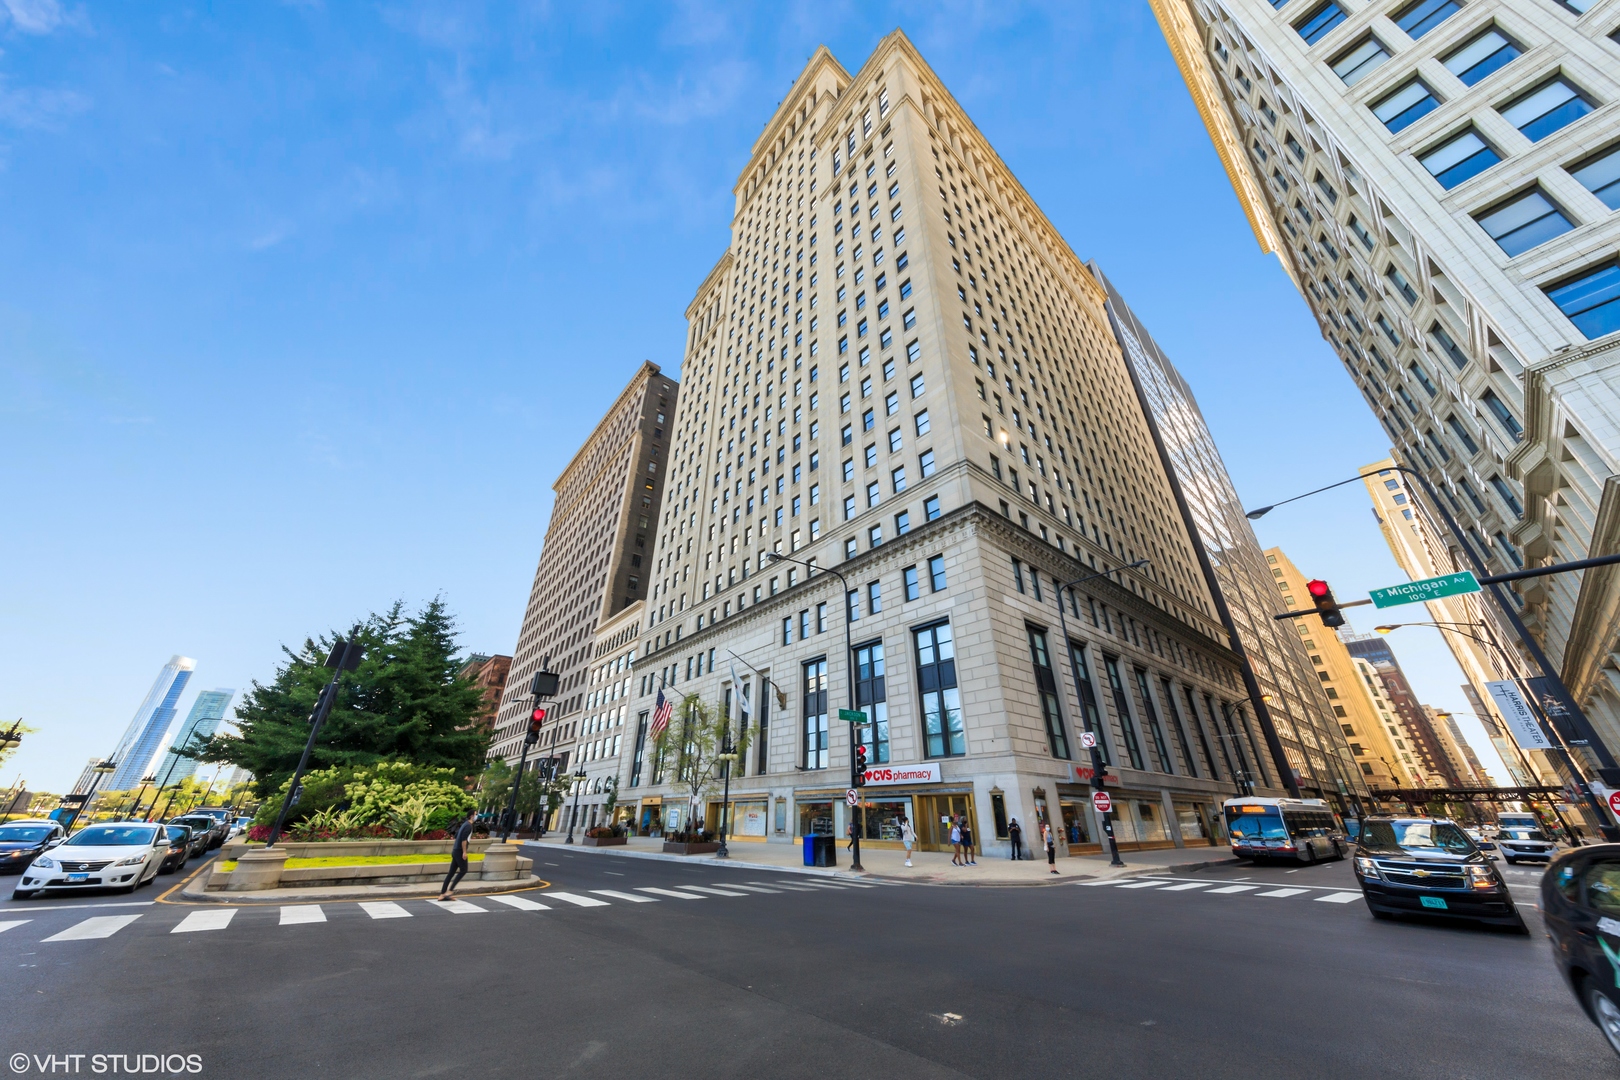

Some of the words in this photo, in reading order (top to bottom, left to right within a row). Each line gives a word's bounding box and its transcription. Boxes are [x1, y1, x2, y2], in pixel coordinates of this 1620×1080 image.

[1386, 580, 1448, 597] Michigan
[1408, 592, 1426, 601] 100
[1508, 691, 1528, 718] HARRIS
[1522, 714, 1544, 744] THEATER
[873, 769, 892, 781] CVS
[893, 770, 931, 782] pharmacy
